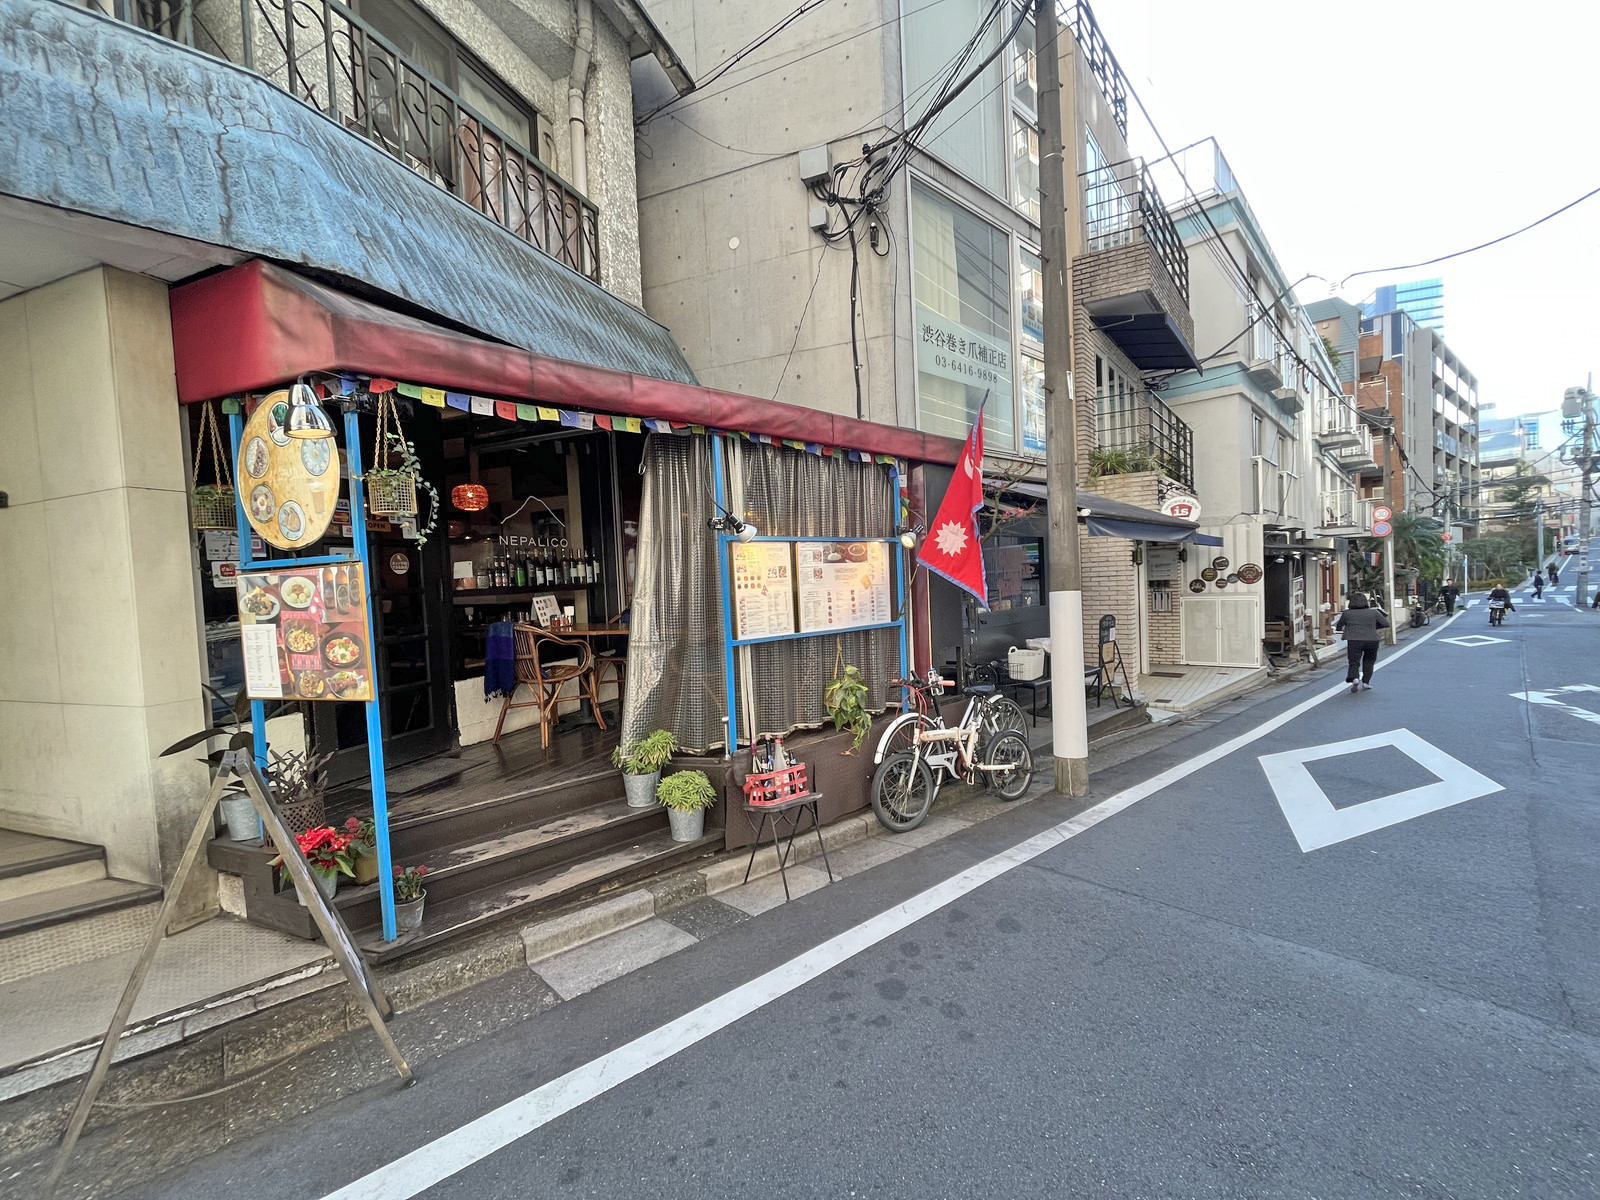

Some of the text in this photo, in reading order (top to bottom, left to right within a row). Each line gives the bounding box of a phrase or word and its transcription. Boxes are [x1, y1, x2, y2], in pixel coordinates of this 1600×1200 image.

[922, 323, 1007, 370] 渋谷巻き爪補正店
[935, 353, 998, 384] 03-6416-9898
[1173, 505, 1189, 515] is
[1376, 510, 1386, 518] 30
[499, 535, 568, 548] NEPALICO
